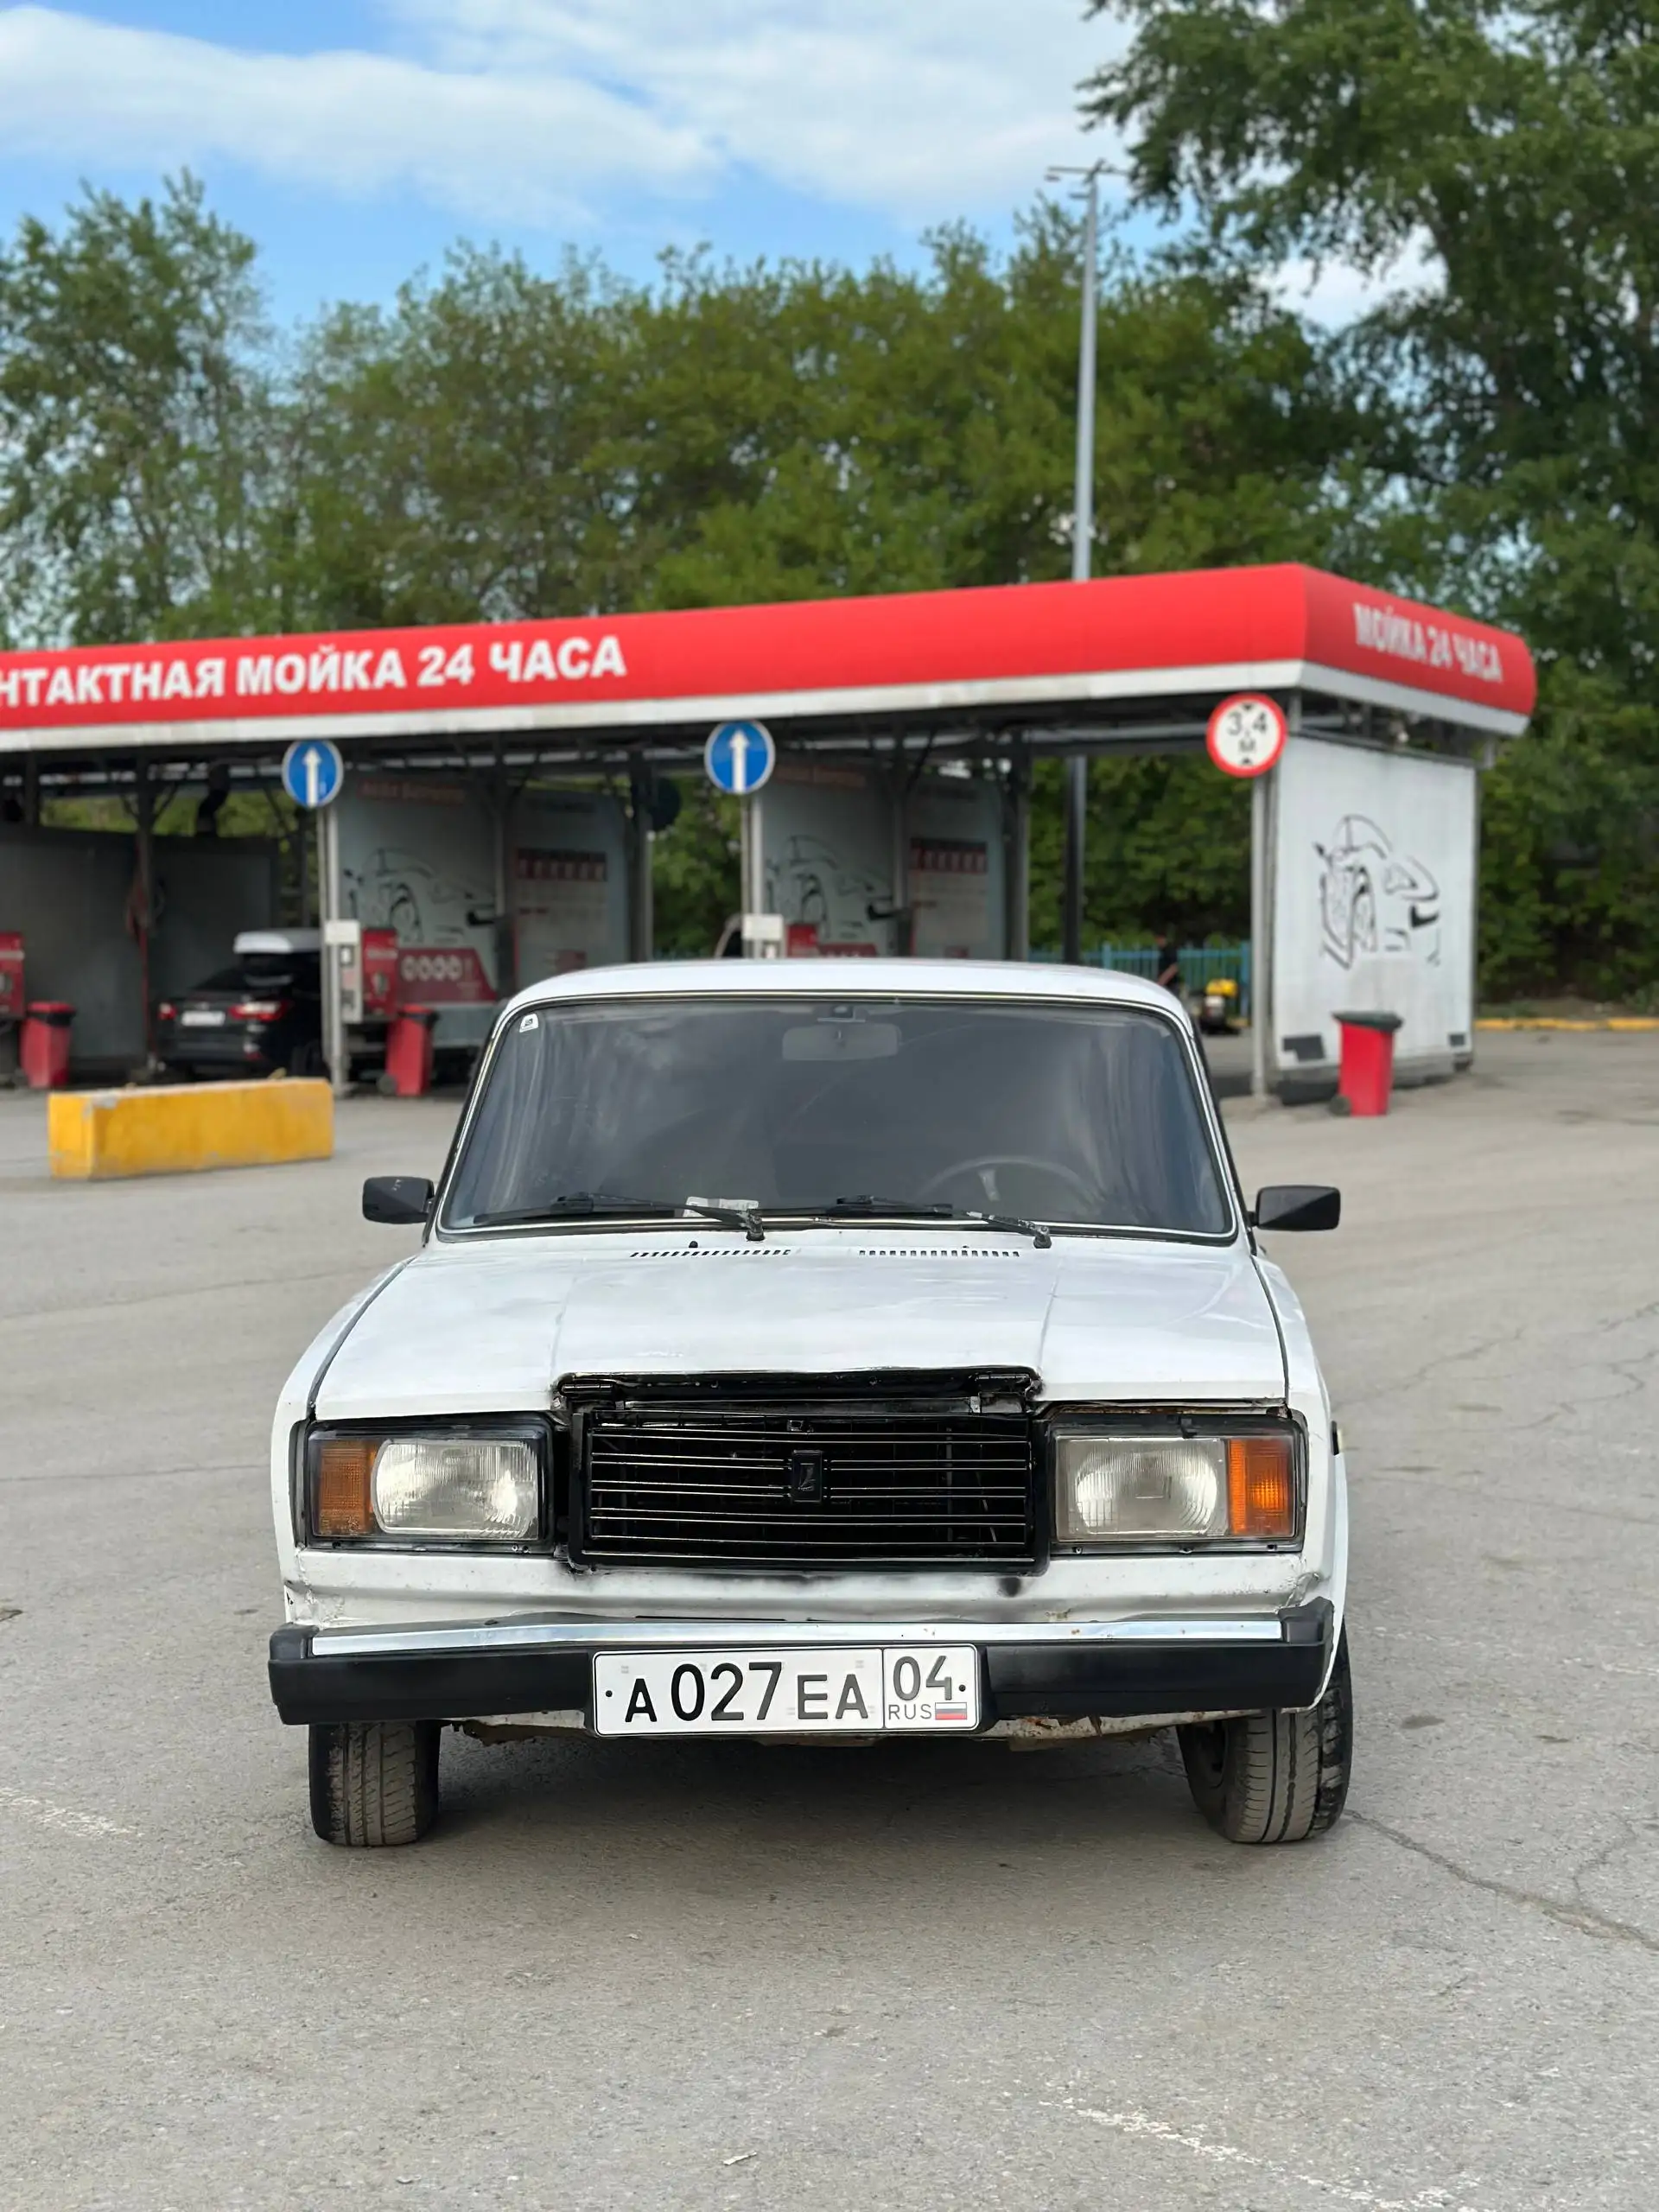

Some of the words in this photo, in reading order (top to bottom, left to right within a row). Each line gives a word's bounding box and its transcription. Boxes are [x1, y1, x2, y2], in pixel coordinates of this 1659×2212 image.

[0, 658, 227, 709] НТАКТНАЯ
[236, 644, 407, 696] МОЙКА
[416, 645, 474, 688] 24
[488, 635, 627, 683] ЧАСА
[1352, 602, 1426, 662] МОЙКА
[1426, 625, 1453, 669] 24
[1452, 631, 1503, 683] ЧАСА
[893, 1655, 952, 1702] 04
[887, 1703, 933, 1720] RUS
